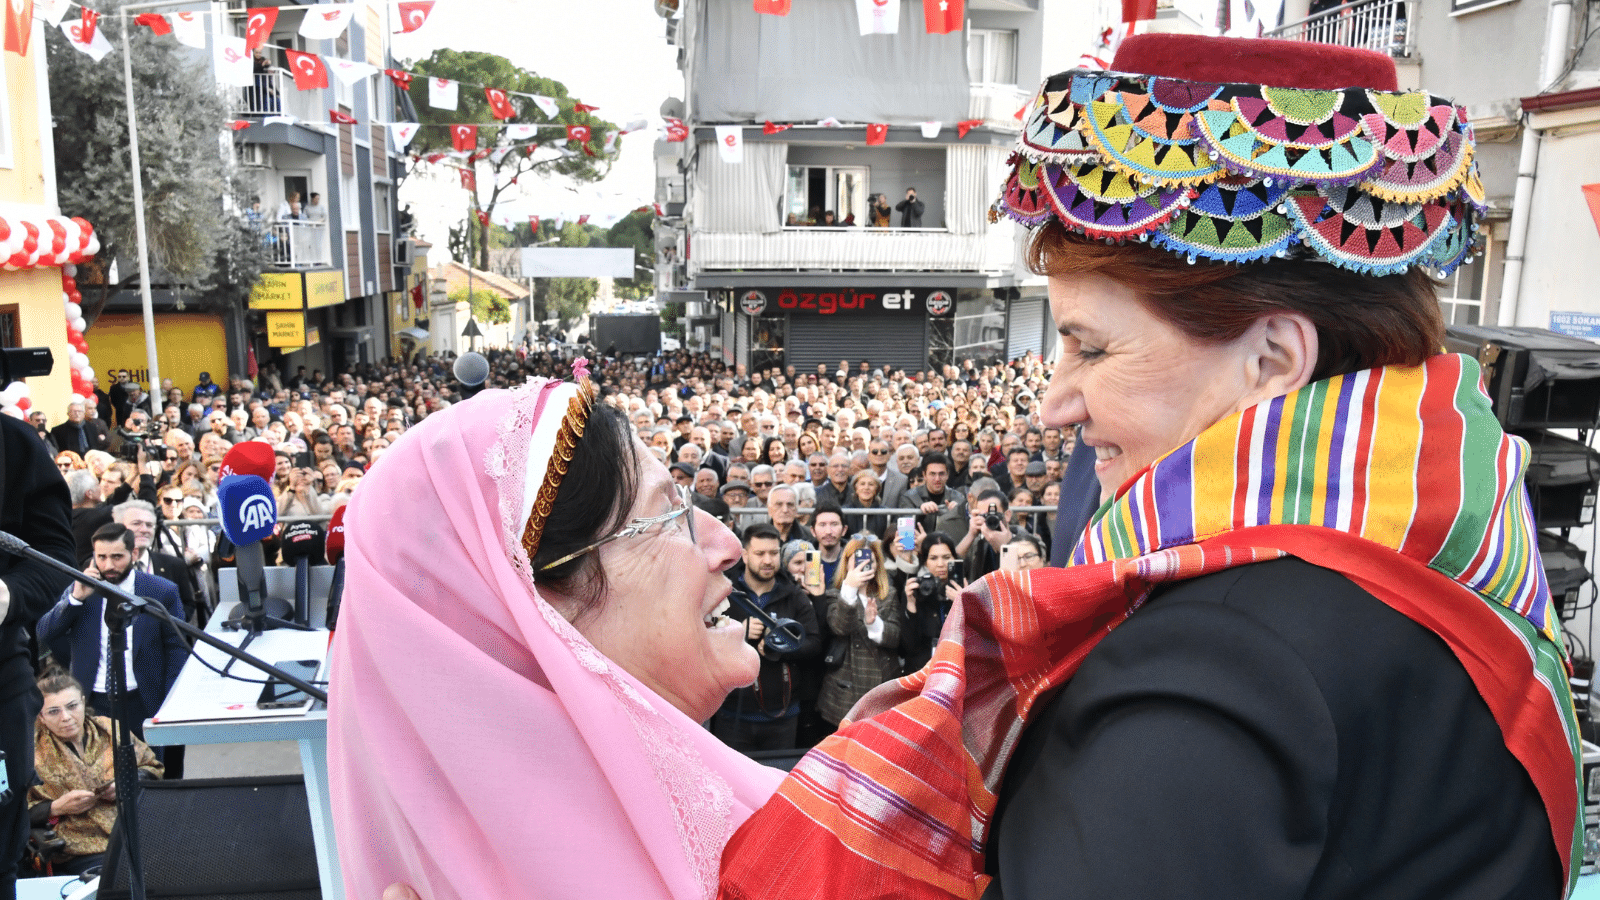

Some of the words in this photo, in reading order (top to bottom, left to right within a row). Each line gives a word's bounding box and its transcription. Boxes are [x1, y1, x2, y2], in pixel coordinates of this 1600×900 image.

[778, 288, 877, 315] özgür
[882, 289, 915, 310] et
[242, 503, 274, 533] AA
